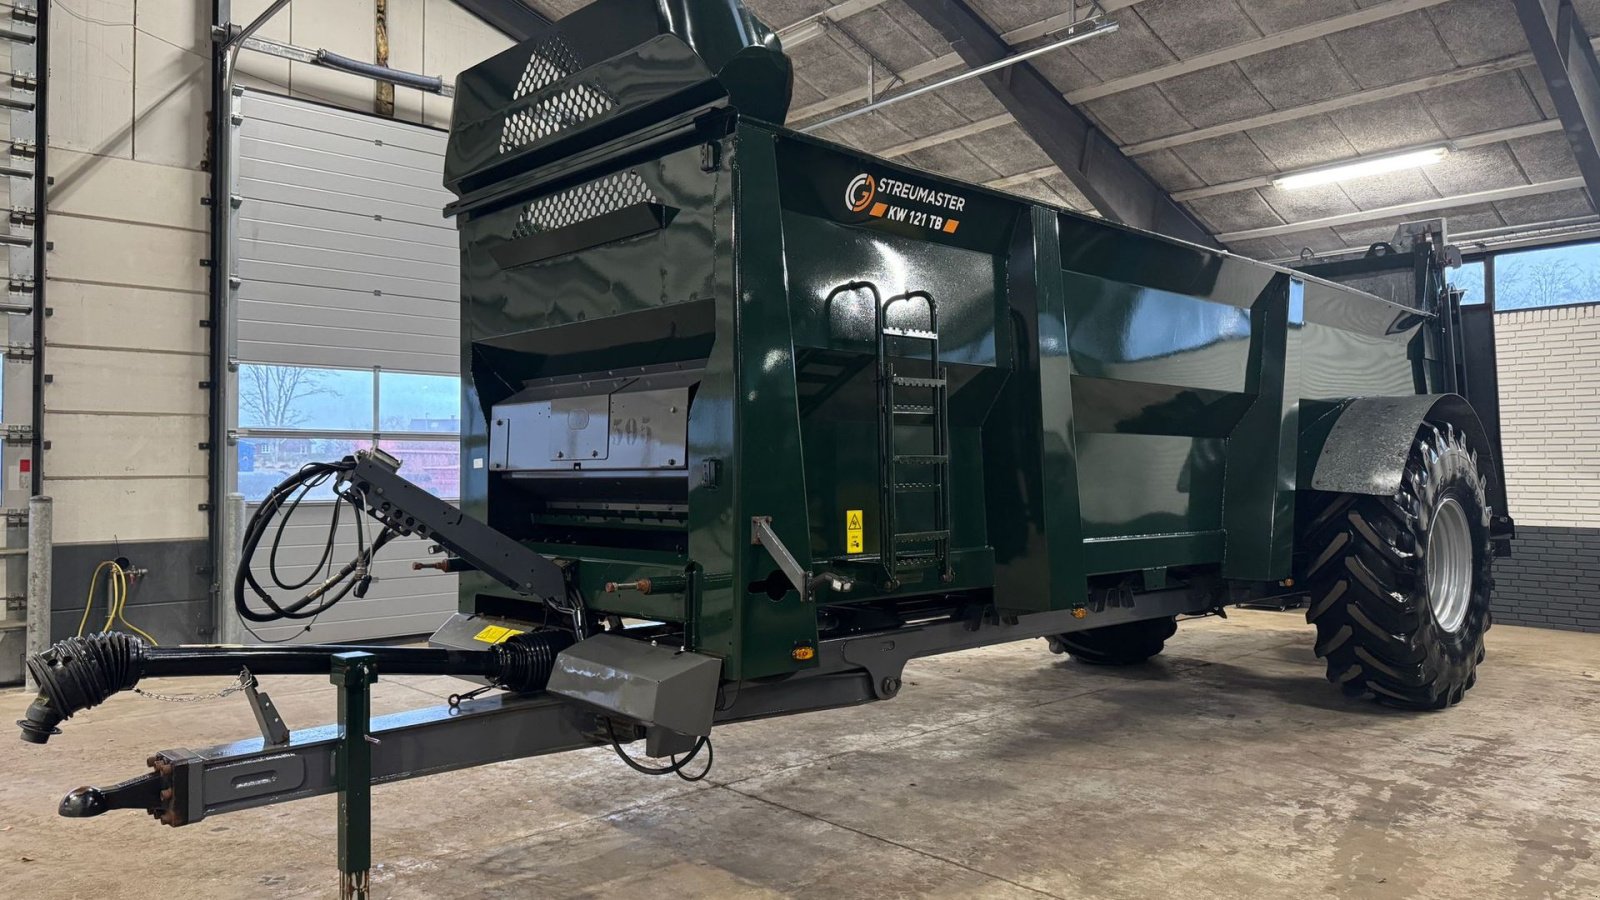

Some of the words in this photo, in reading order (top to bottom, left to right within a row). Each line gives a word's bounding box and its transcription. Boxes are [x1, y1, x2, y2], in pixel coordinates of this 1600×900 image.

[878, 178, 965, 211] STREUMASTER
[888, 205, 908, 222] KW
[909, 211, 926, 226] 121
[929, 215, 944, 230] TB
